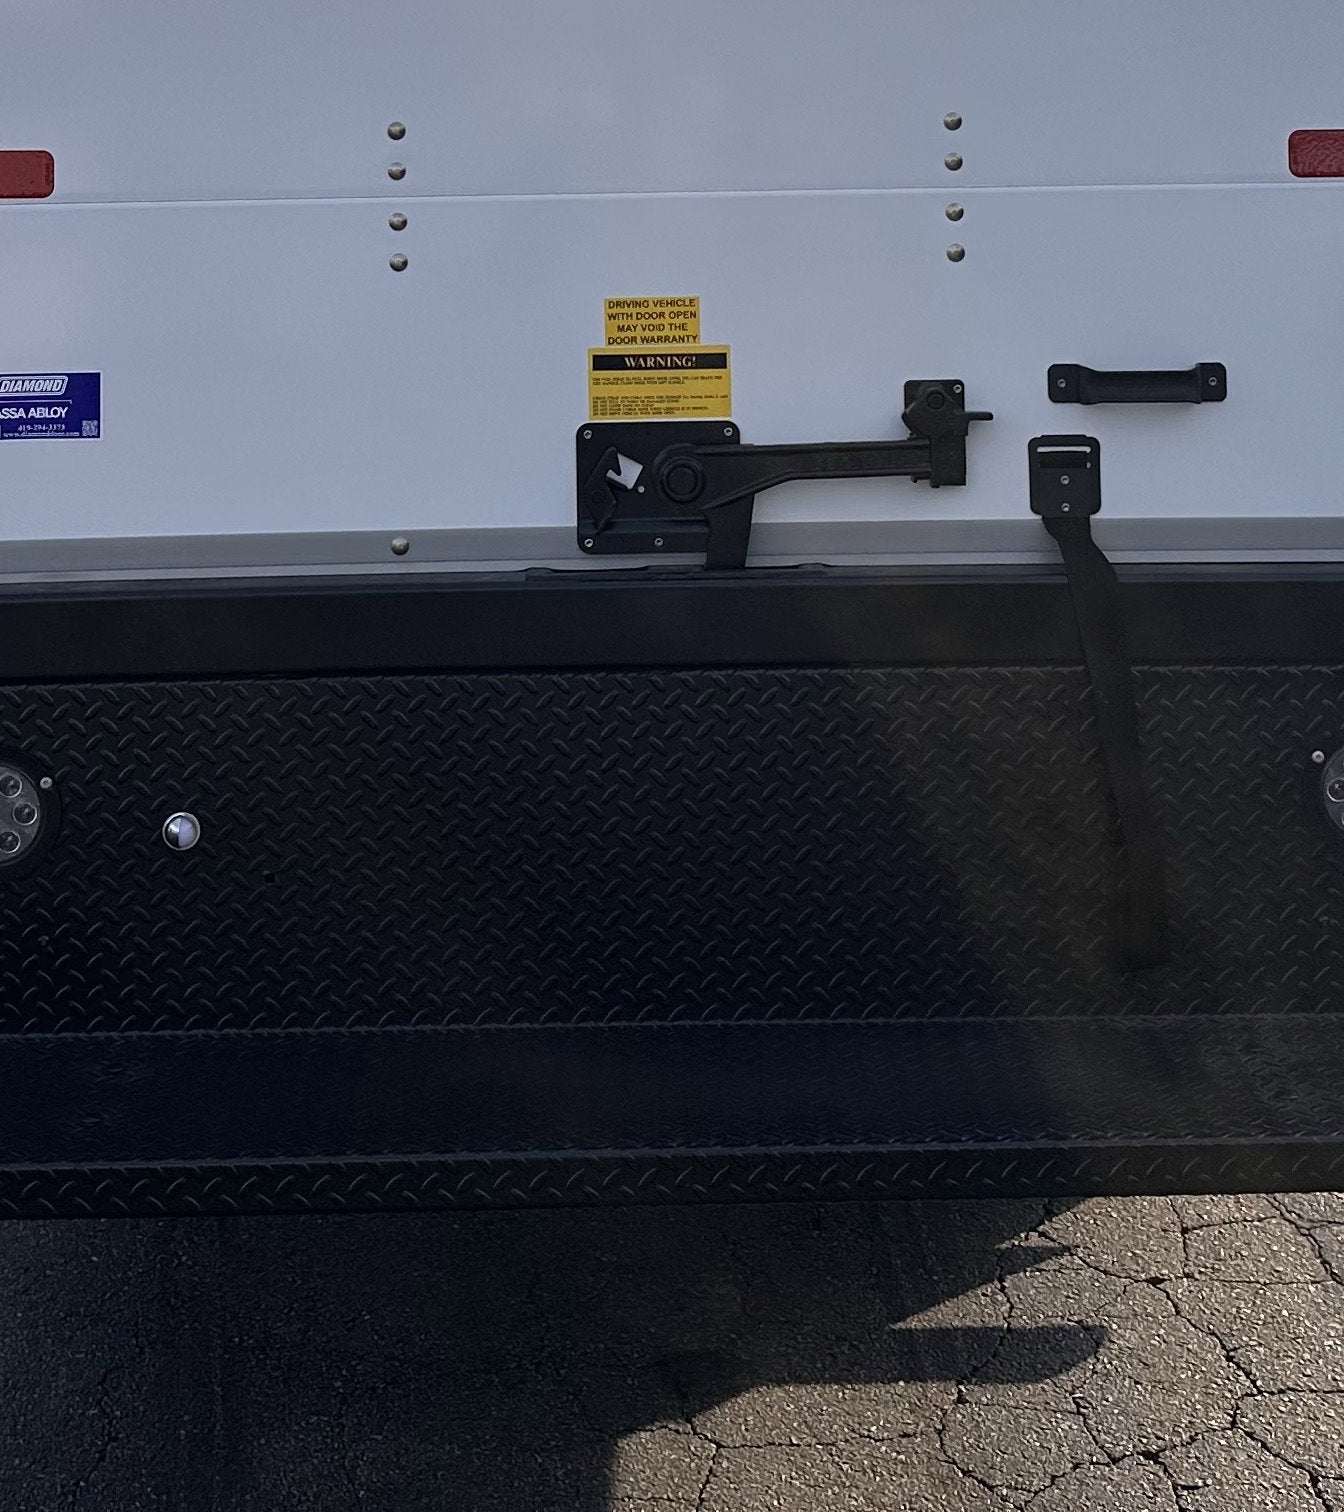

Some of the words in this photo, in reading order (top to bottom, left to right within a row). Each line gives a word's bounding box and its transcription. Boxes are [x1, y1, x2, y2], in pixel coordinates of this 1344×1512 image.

[608, 299, 650, 309] DRIVING
[652, 298, 696, 308] VEHICLE
[607, 312, 633, 321] WITH
[636, 311, 665, 320] DOOR
[668, 310, 697, 319] OPEN
[617, 323, 638, 333] MAY
[640, 323, 666, 332] VOID
[667, 322, 688, 332] THE
[607, 336, 637, 345] DOOR
[640, 334, 698, 344] WARRANTY
[624, 355, 696, 368] WARNING!
[0, 379, 62, 393] DIAMOND
[27, 406, 69, 419] ABLOY
